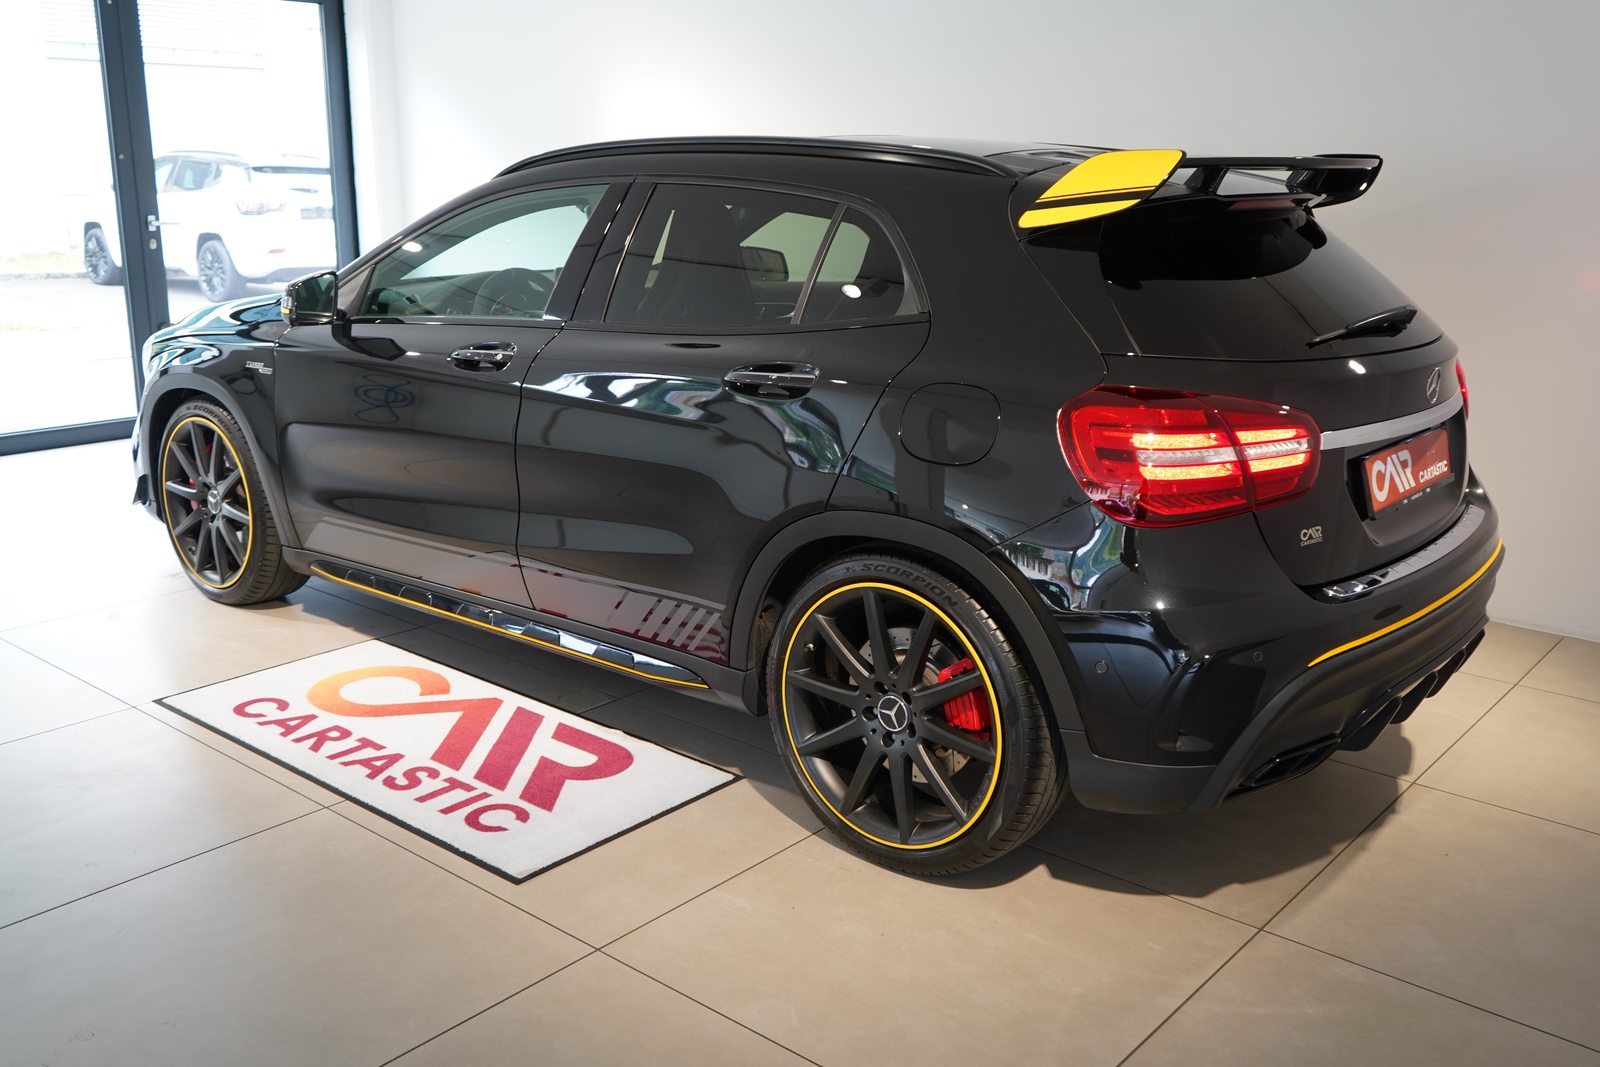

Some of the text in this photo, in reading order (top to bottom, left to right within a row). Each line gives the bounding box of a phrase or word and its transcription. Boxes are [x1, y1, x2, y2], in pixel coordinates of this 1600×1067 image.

[1419, 460, 1448, 483] CARTASTIC
[861, 563, 958, 608] SCORPION
[232, 697, 530, 832] CARTASTIC
